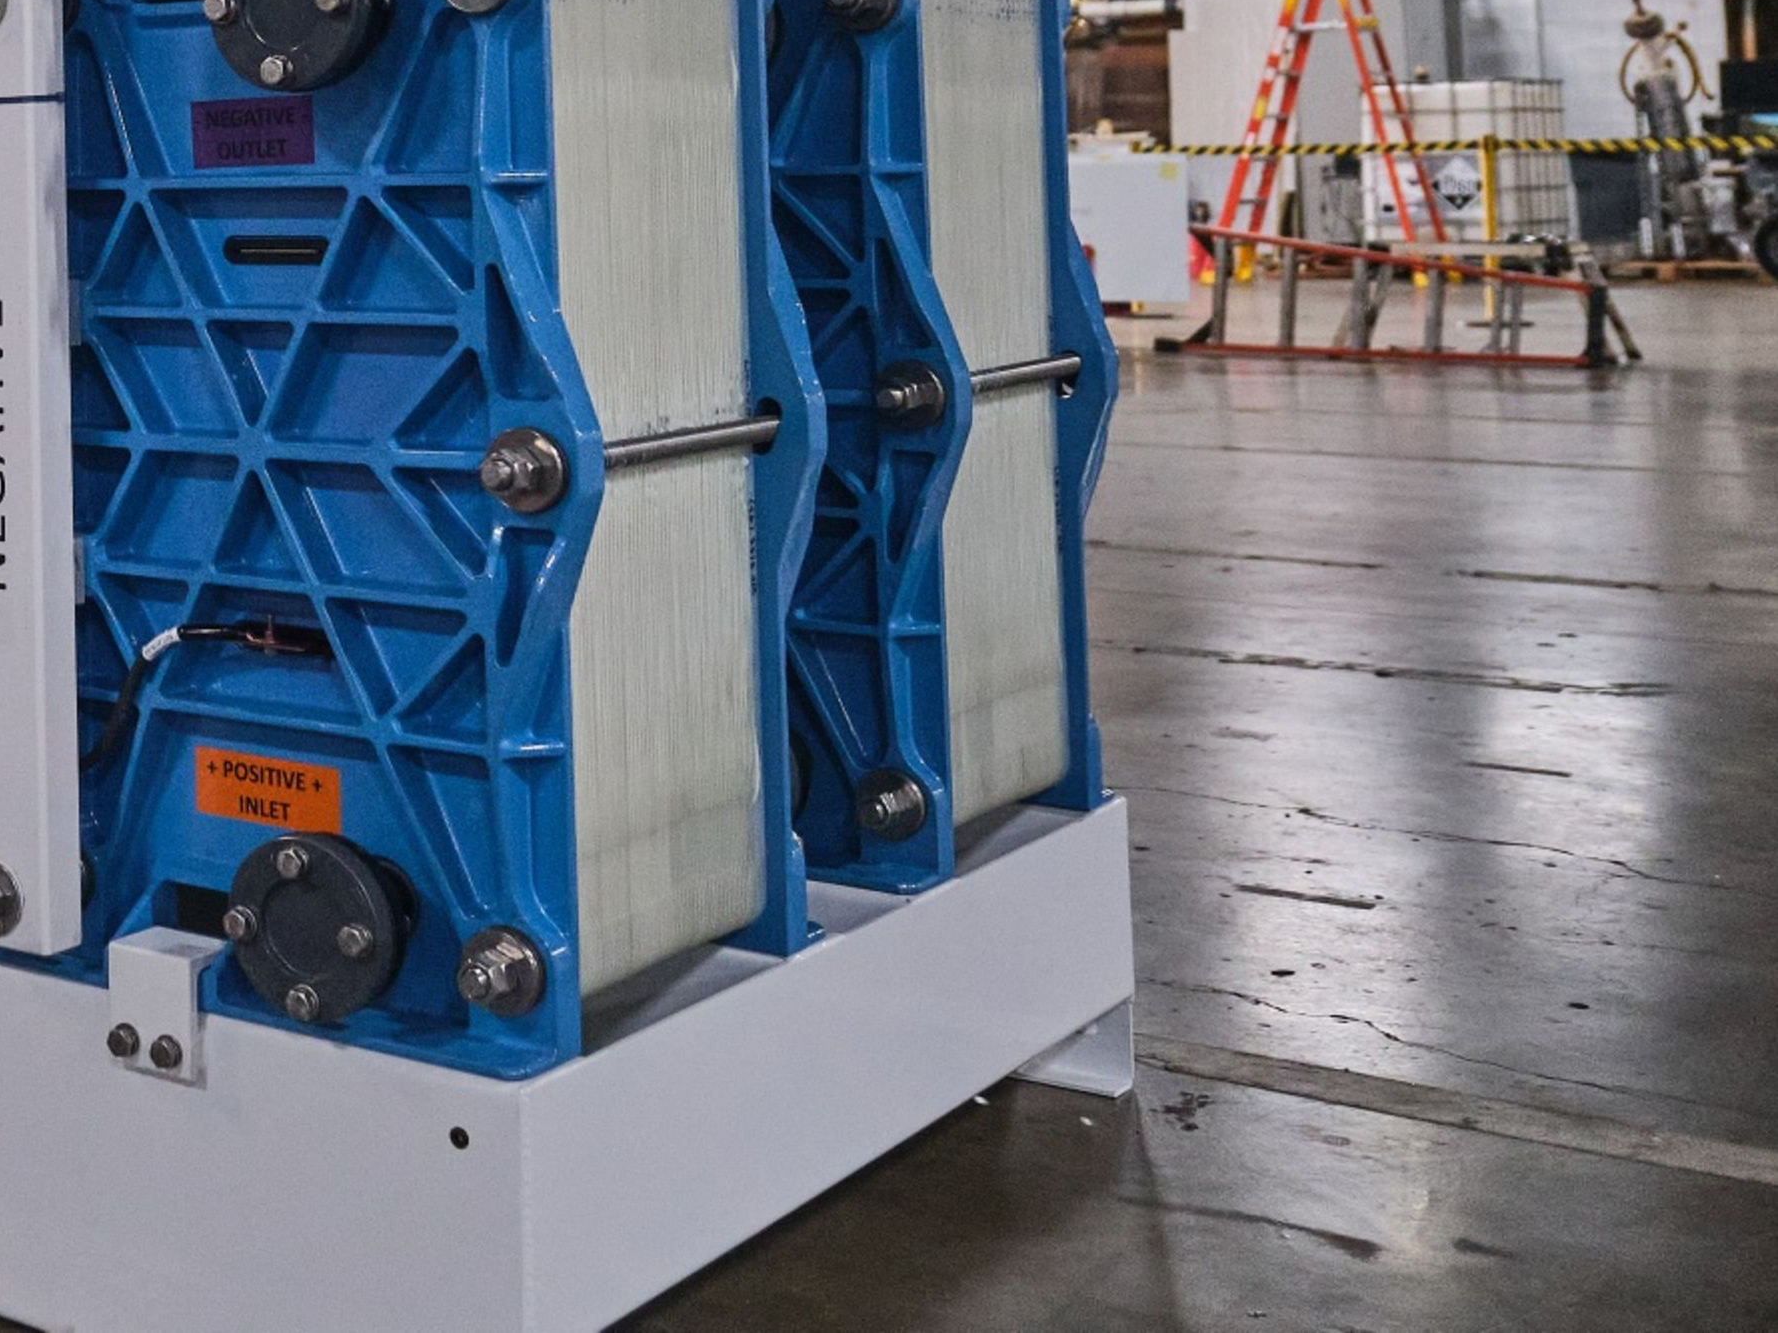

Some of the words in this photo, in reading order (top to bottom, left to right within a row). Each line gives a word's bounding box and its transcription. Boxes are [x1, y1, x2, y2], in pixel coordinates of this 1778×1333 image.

[205, 106, 295, 129] NEGATIVE
[217, 138, 287, 160] OUTLET
[223, 760, 307, 791] POSITIVE
[239, 795, 291, 821] INLET
